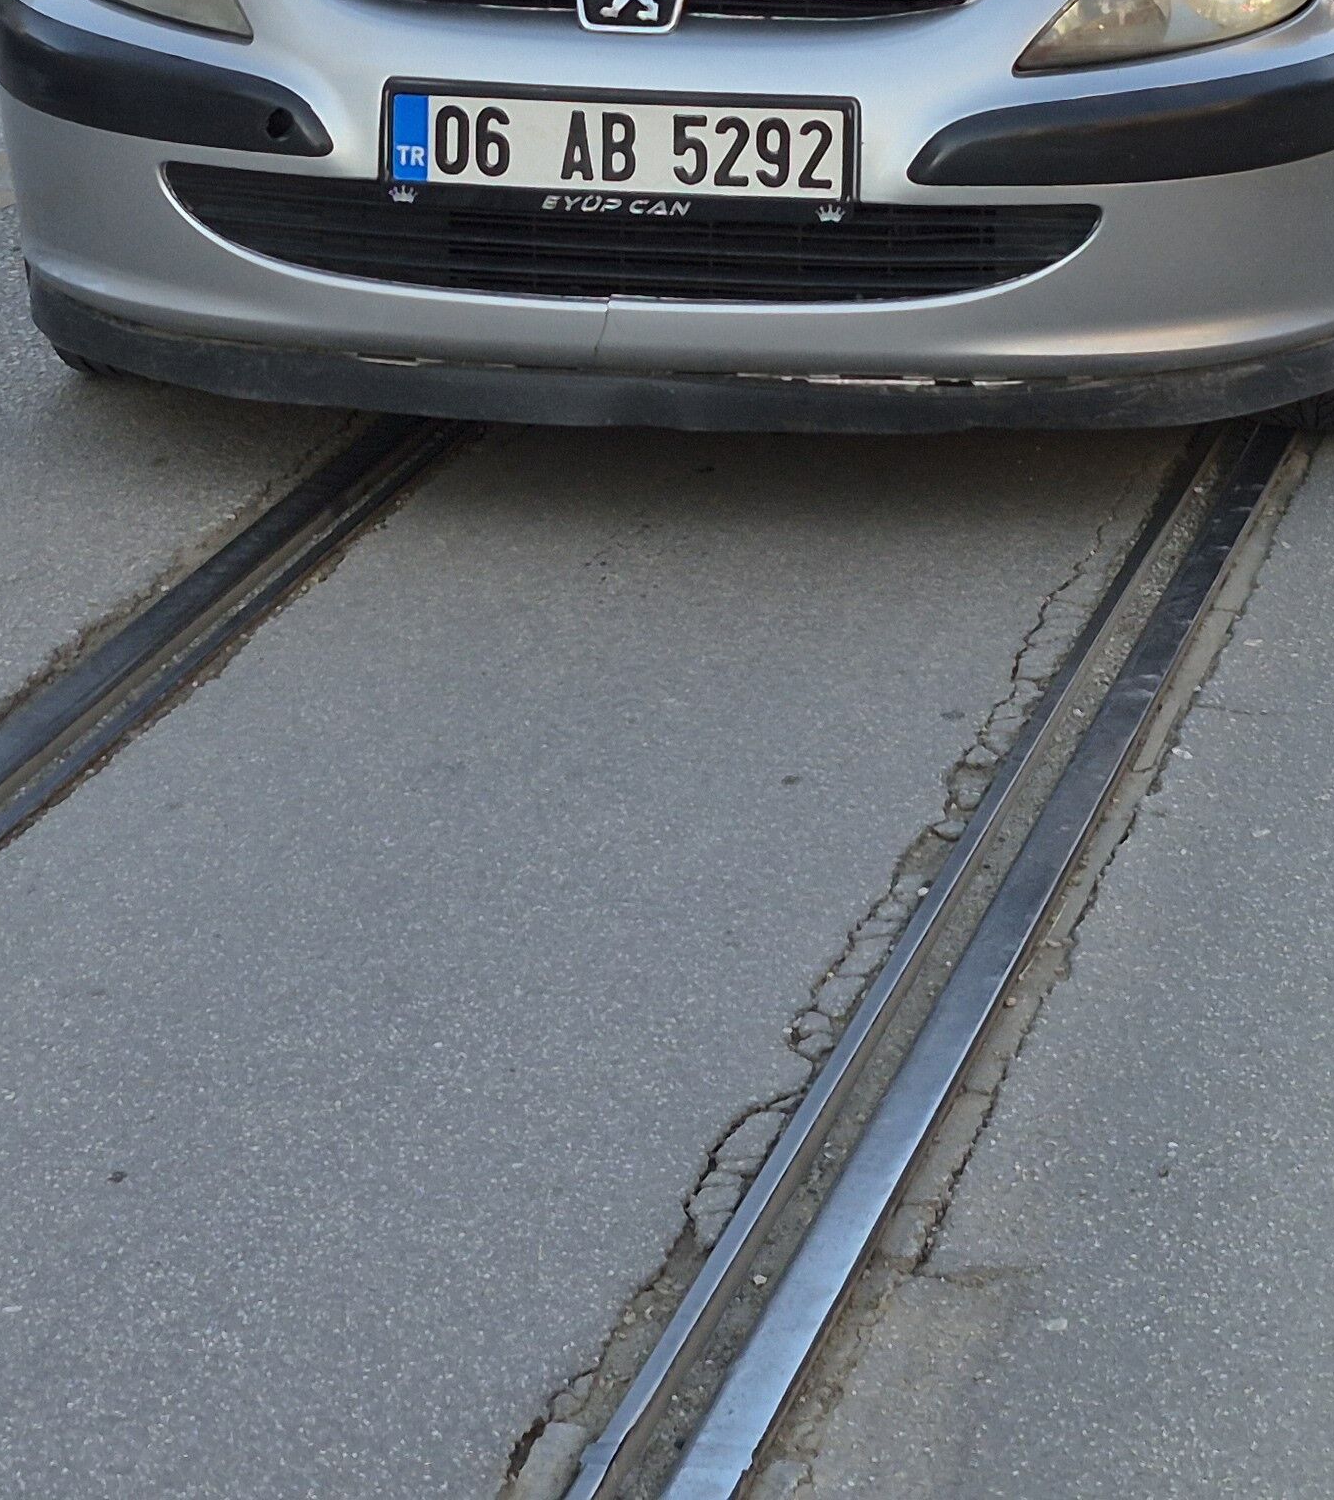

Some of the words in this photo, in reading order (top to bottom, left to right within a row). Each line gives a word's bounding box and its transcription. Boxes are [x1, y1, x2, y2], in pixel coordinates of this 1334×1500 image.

[397, 144, 425, 167] TR
[434, 104, 511, 178] 06
[560, 110, 636, 183] AB
[672, 113, 833, 189] 5292
[629, 199, 692, 217] CAN
